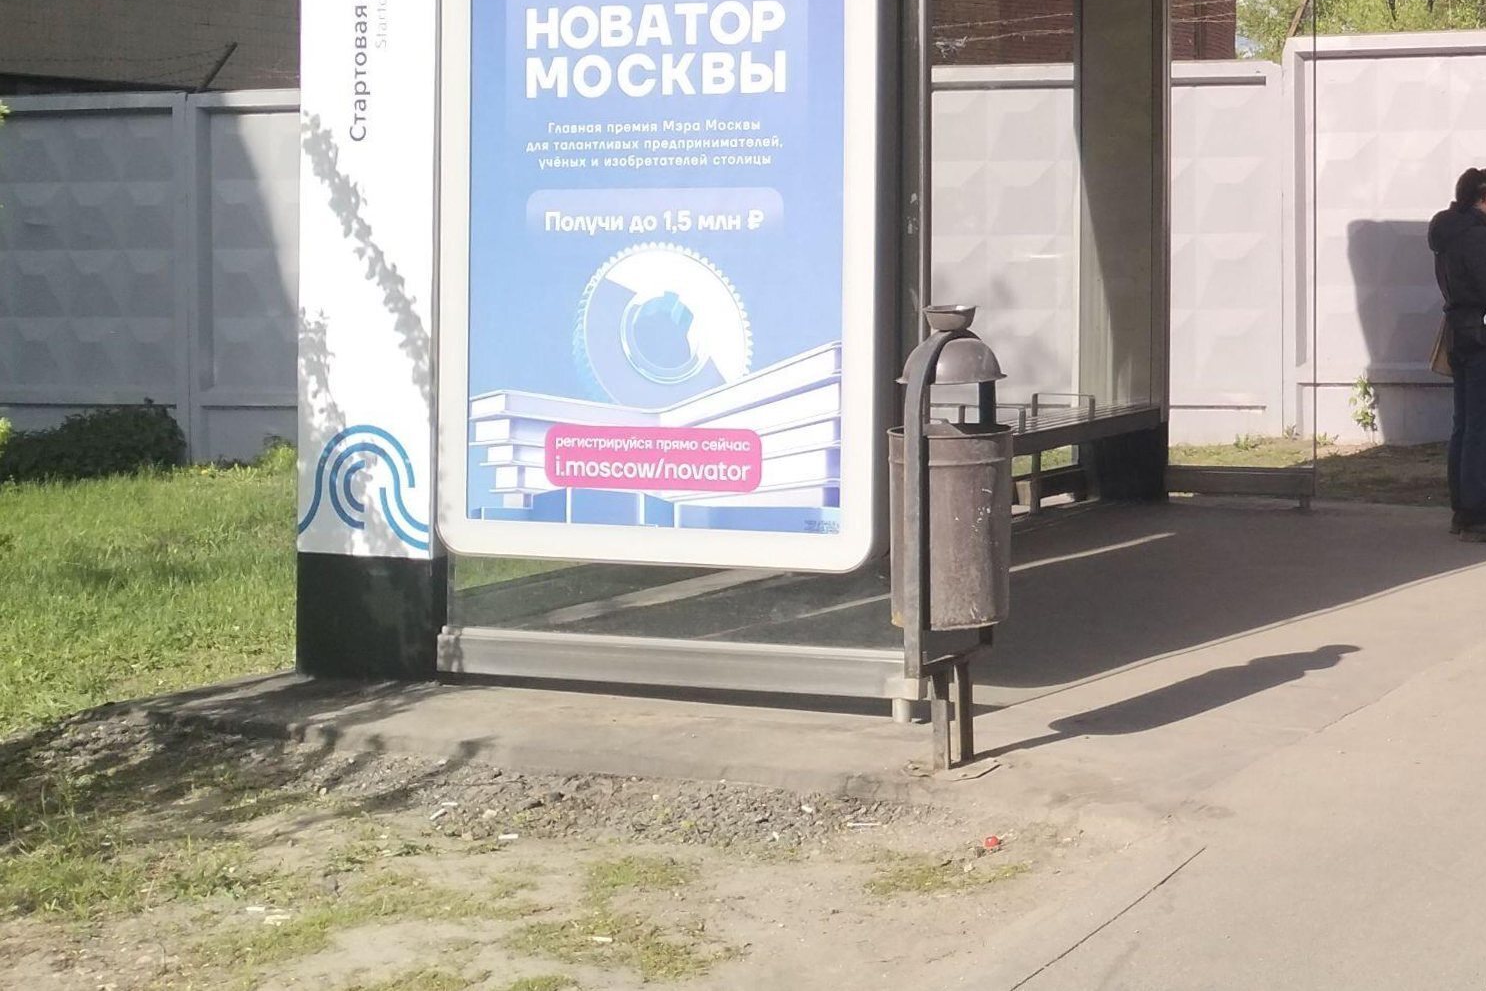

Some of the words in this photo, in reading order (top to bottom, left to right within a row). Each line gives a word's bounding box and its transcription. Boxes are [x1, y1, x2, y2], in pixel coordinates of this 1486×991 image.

[526, 0, 786, 49] НОВАТОР
[350, 5, 370, 141] Стартовая
[526, 50, 786, 99] МОСКВЫ
[548, 122, 602, 134] Главная
[607, 122, 658, 135] премия
[663, 120, 701, 134] Мэра
[705, 119, 761, 131] Москвы
[526, 141, 549, 152] для
[553, 140, 639, 151] талантливых
[644, 136, 783, 151] предпринимателей,
[538, 156, 587, 169] учёных
[591, 158, 599, 167] и
[604, 154, 708, 169] изобретателей
[713, 155, 772, 167] столицы
[544, 210, 624, 236] Получи
[628, 214, 658, 234] до
[663, 209, 692, 234] 1,5
[697, 213, 741, 231] млн
[555, 436, 652, 452] регистрируйся
[656, 438, 698, 453] прямо
[701, 437, 750, 452] сейчас
[555, 455, 751, 482] i.moscow/novator
